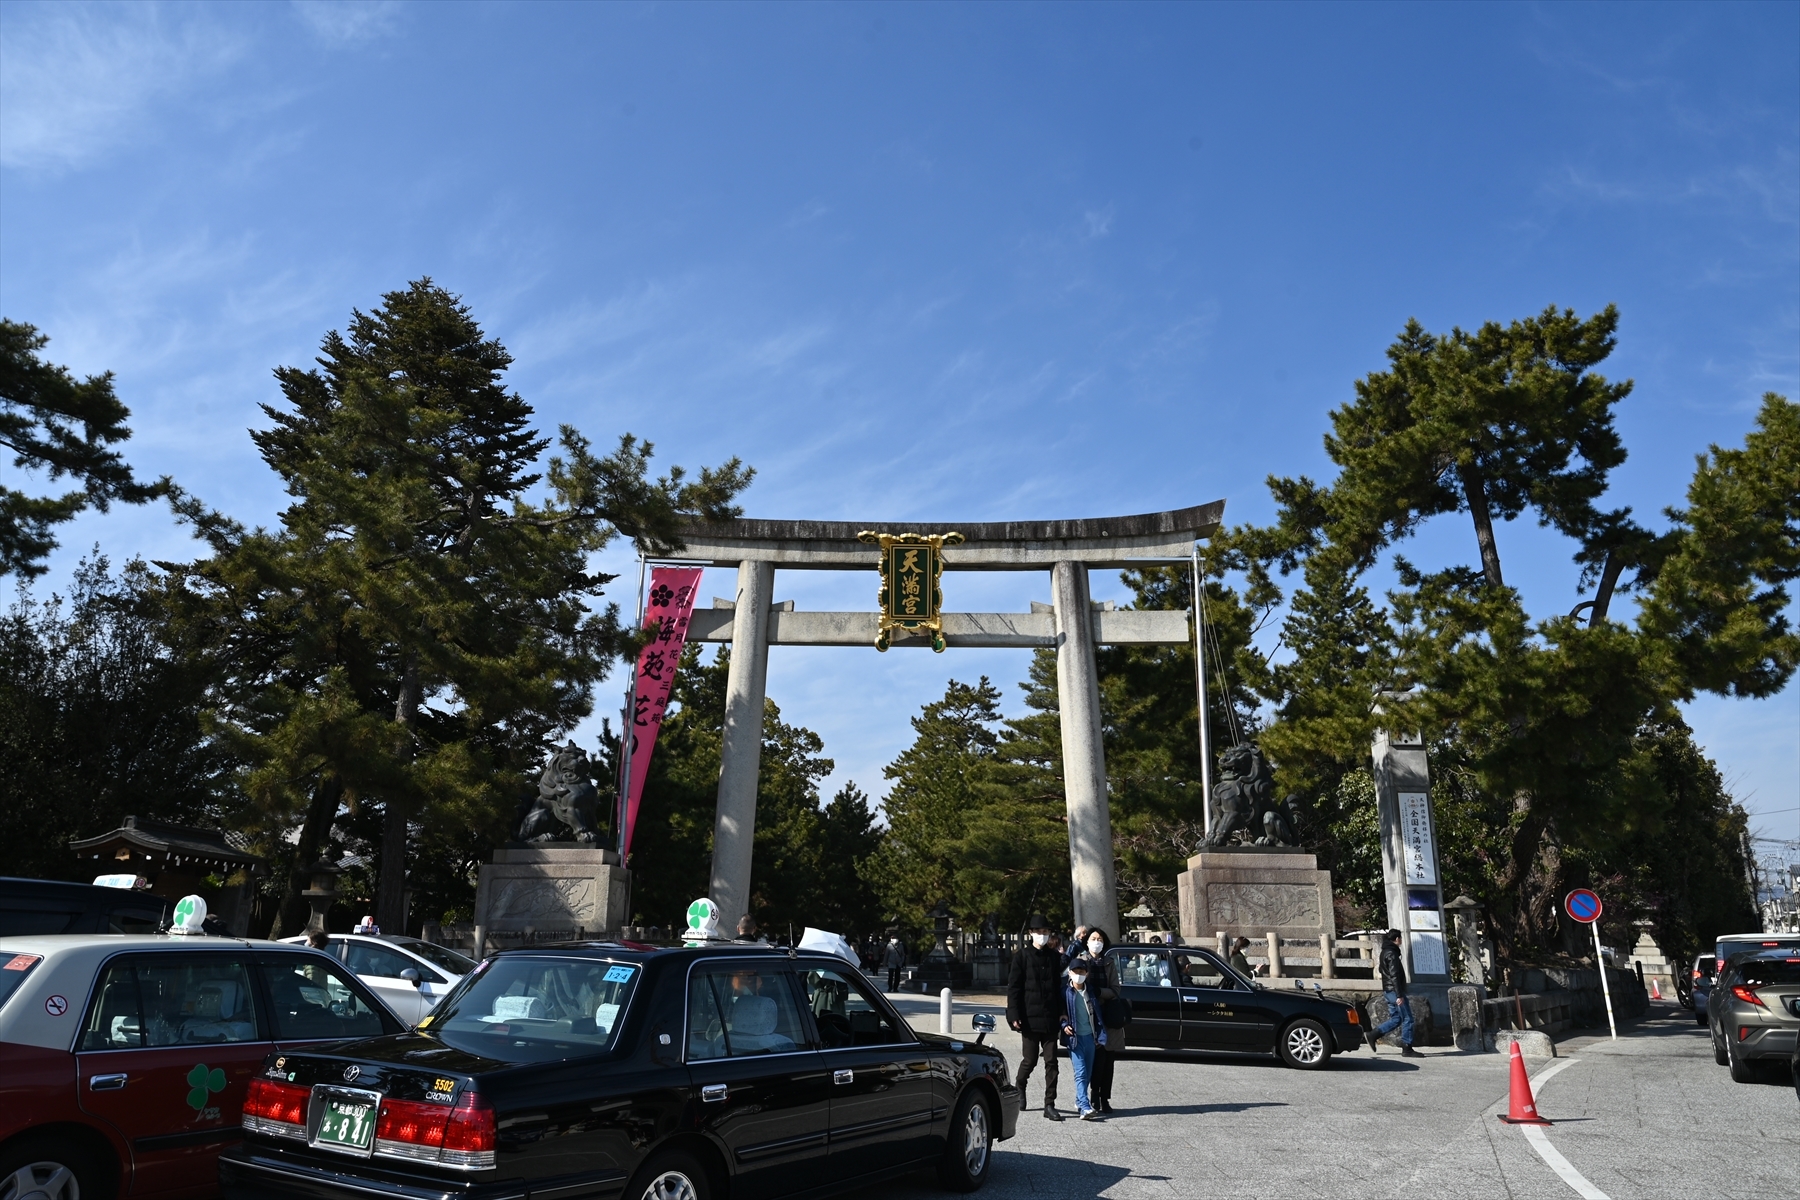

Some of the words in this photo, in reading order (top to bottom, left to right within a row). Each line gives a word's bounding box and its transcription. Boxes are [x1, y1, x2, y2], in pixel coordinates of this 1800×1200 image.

[899, 549, 925, 614] 天満宮
[651, 616, 689, 724] 雪月花の三庭苑
[1409, 809, 1425, 879] 全国天満宮総本社
[425, 1091, 454, 1102] CROWN
[434, 1078, 455, 1092] 5502
